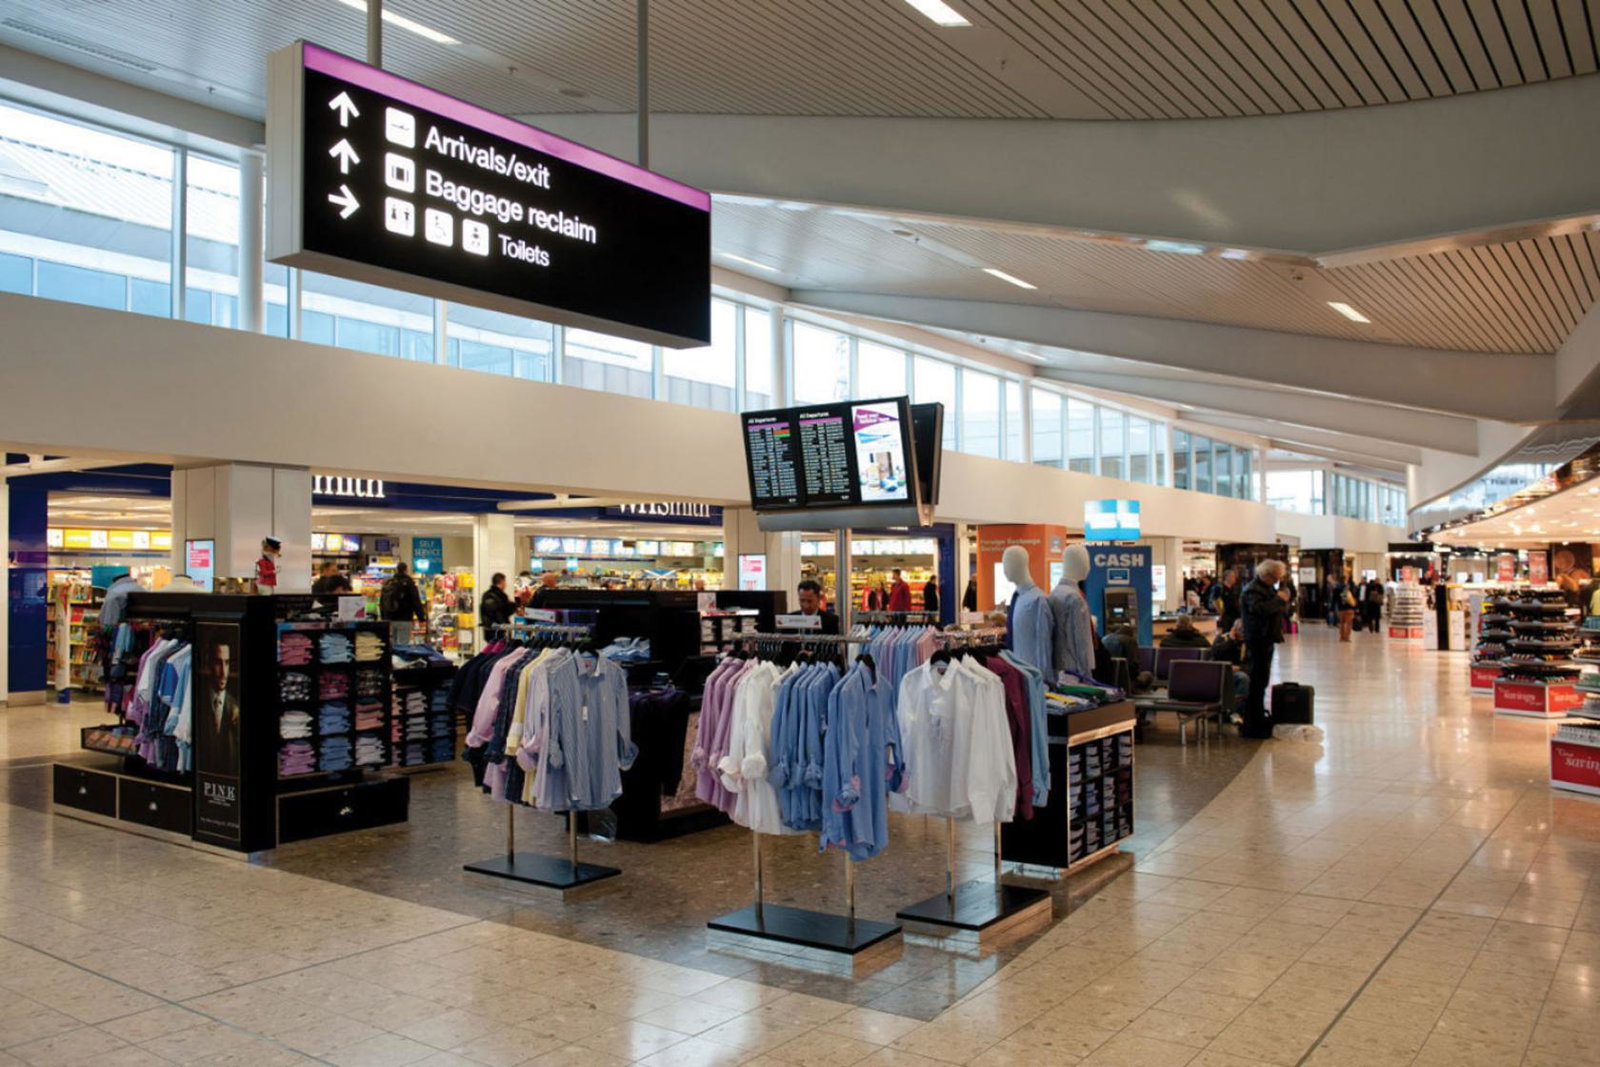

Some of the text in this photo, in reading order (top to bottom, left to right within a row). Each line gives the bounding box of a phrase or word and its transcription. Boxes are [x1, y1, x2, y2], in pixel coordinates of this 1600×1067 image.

[424, 126, 550, 190] Arrivals/exit
[425, 169, 598, 245] Baggage reclaim
[498, 233, 551, 268] Toilets
[1093, 553, 1145, 568] CASH
[204, 782, 235, 801] PINK
